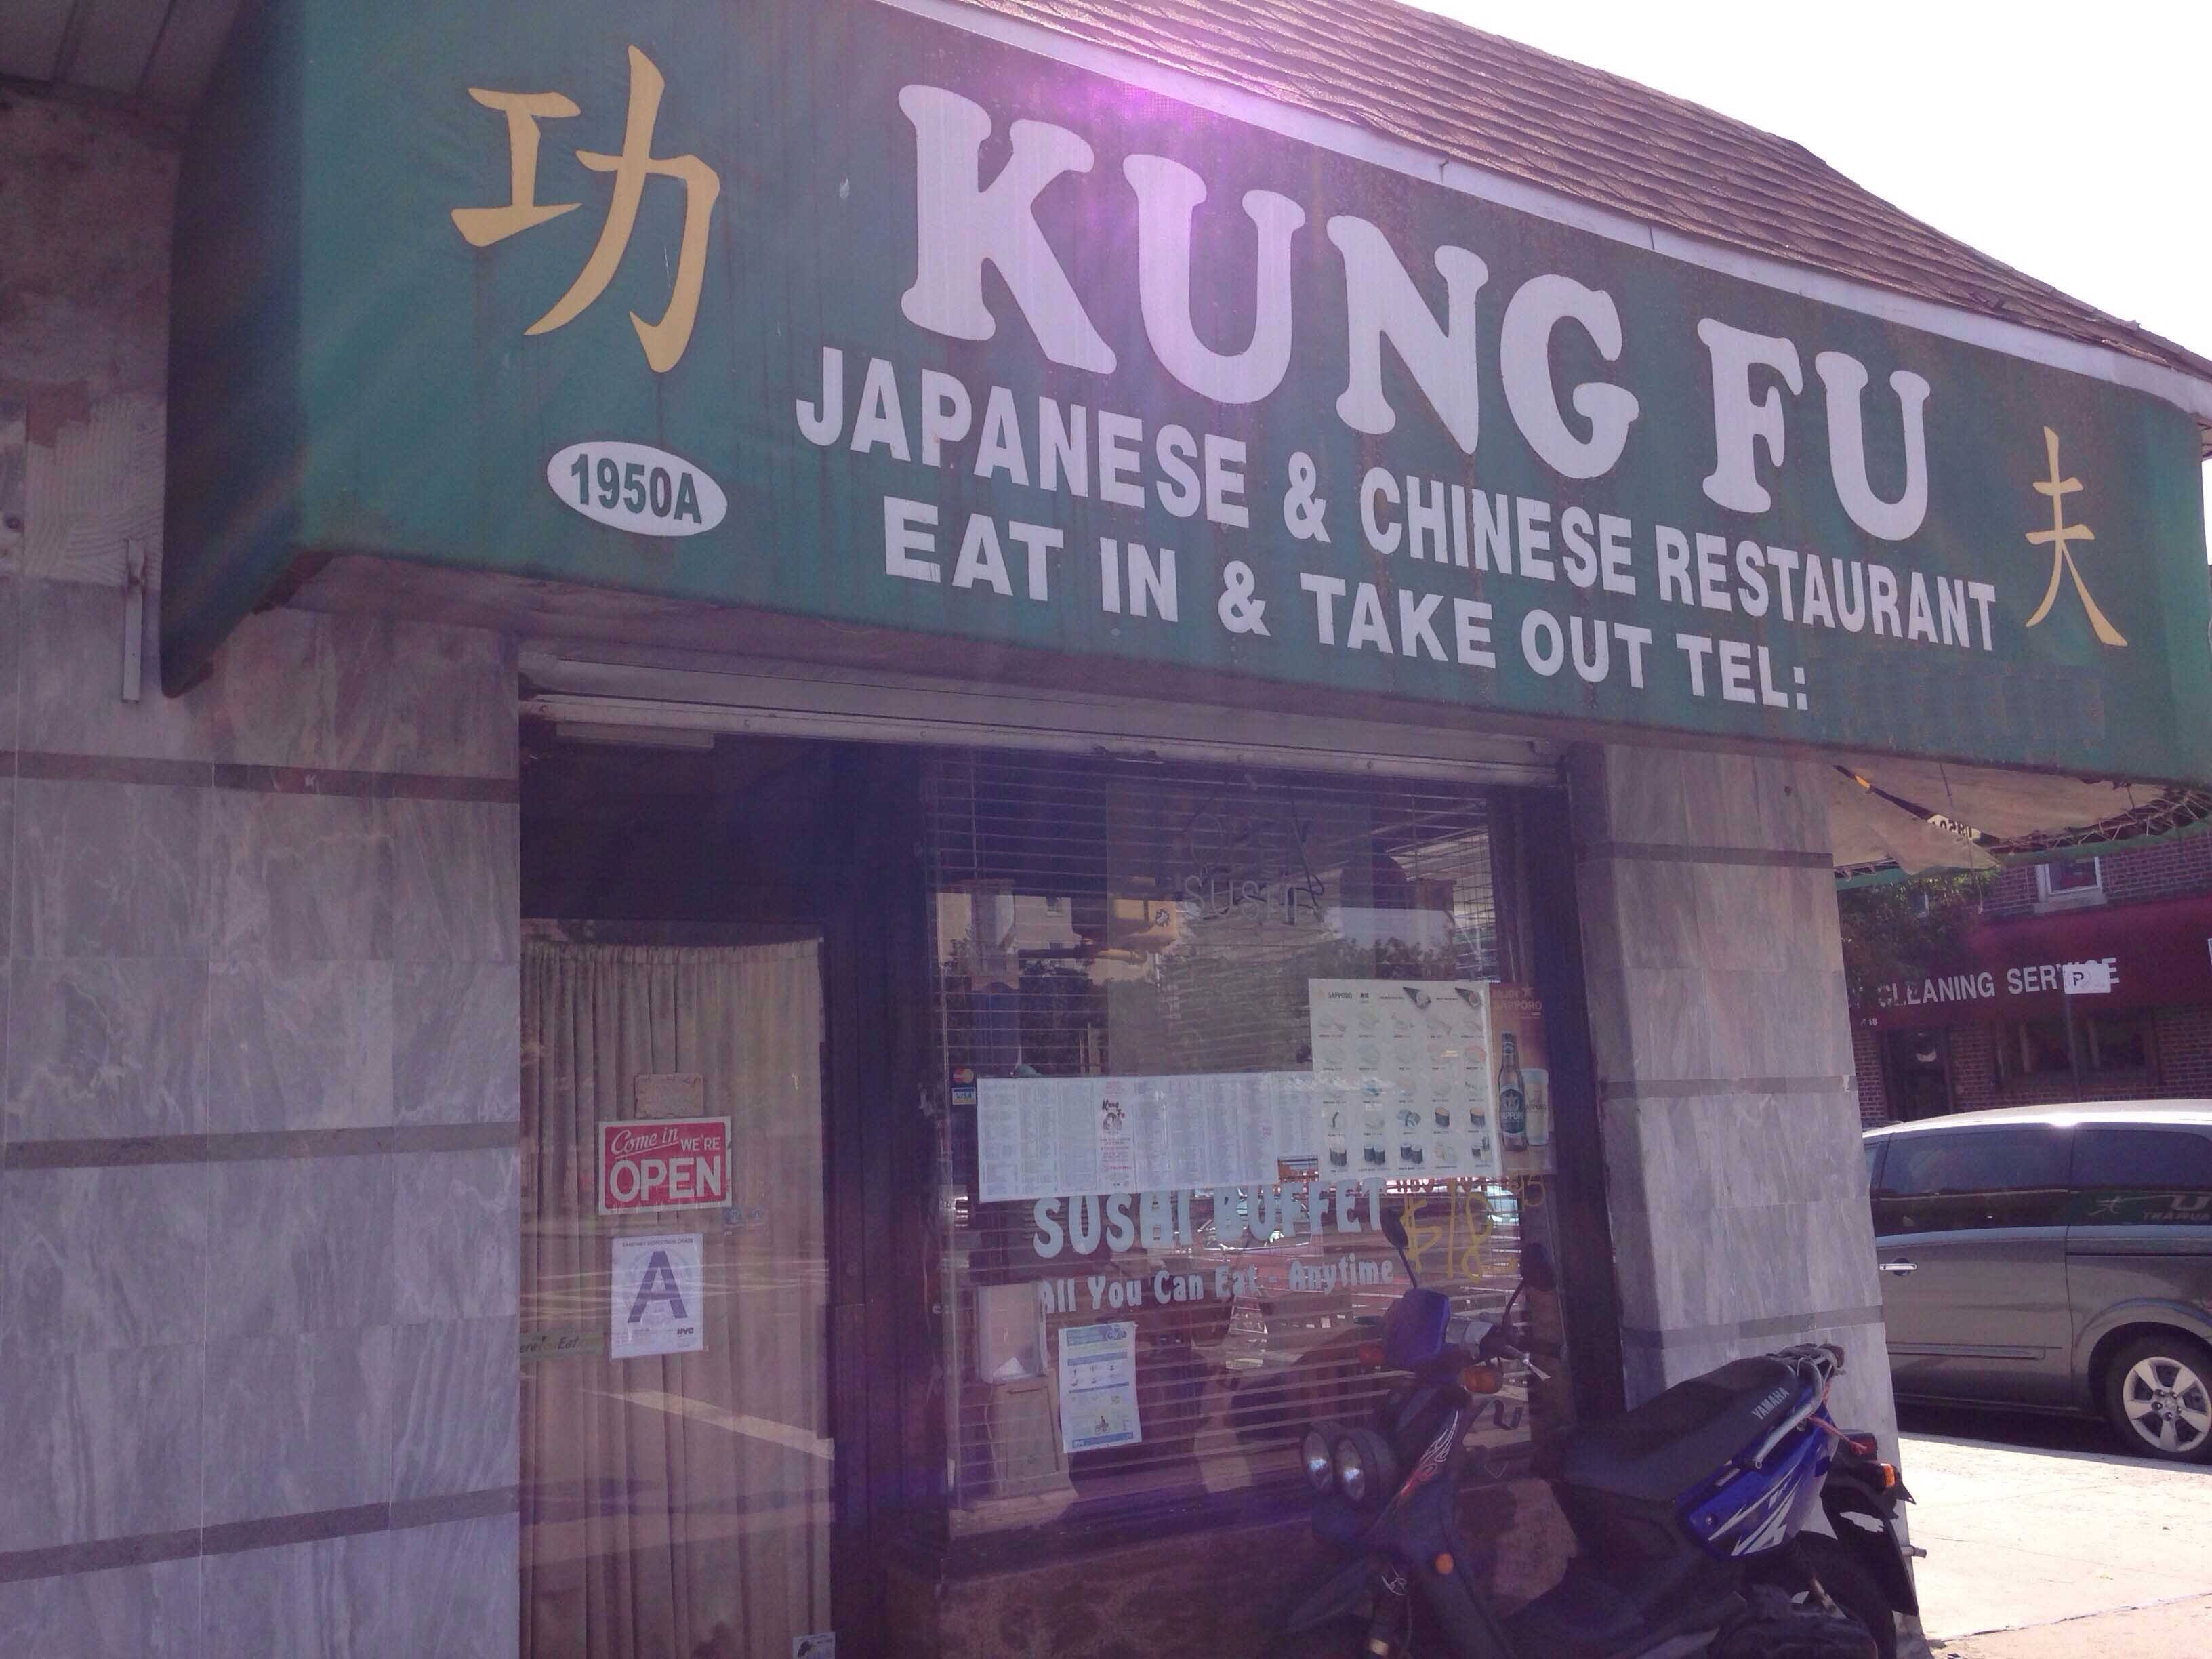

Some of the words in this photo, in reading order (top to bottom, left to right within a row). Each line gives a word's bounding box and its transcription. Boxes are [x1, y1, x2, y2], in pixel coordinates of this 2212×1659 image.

[451, 45, 720, 374] 功
[898, 84, 1640, 479] KUNG
[1697, 317, 1931, 541] FU
[571, 453, 702, 525] 1950A
[796, 346, 1250, 529] JAPANESE
[1283, 451, 1332, 543] &
[1359, 466, 1636, 596] CHINESE
[1655, 525, 1996, 651] RESTAURANT
[2026, 426, 2128, 647] 夫
[884, 495, 1064, 602] EAT
[1099, 537, 1179, 623] IN
[1218, 560, 1271, 638] &
[1300, 572, 1496, 668] TAKE
[1521, 609, 1652, 689] OUT
[1675, 632, 1808, 711] TEL:
[2007, 958, 2120, 994] SERE
[609, 1155, 721, 1202] OPEN
[611, 1129, 657, 1156] Come
[662, 1127, 678, 1144] in
[680, 1134, 721, 1152] WE'RE
[1033, 1189, 1193, 1258] SUSHI
[1213, 1178, 1385, 1242] BUFFET
[627, 1250, 689, 1324] A
[1087, 1275, 1142, 1310] You
[1153, 1269, 1204, 1305] Can
[1215, 1263, 1258, 1298] Eat
[1288, 1255, 1394, 1294] Anytime
[1750, 1387, 1790, 1421] YAMAHA
